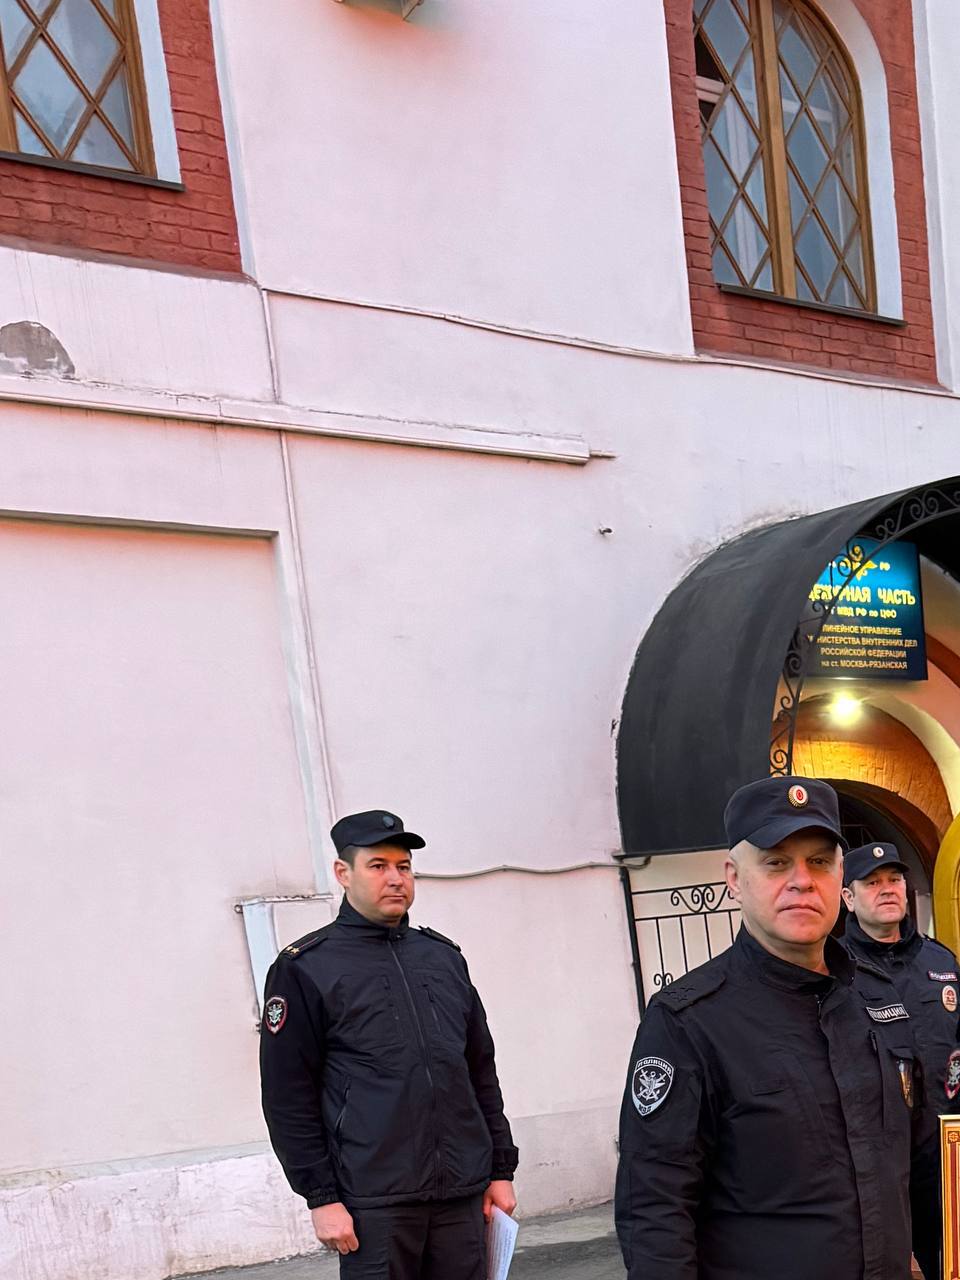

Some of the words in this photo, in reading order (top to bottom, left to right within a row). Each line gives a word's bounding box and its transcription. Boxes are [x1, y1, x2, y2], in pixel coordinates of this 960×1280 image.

[878, 588, 915, 604] ЧАСТЬ
[856, 608, 867, 616] РФ
[880, 609, 896, 618] ЦФО
[822, 624, 860, 634] ЛИНЕЙНОЕ
[860, 626, 902, 635] УПРАВЛЕНИЕ
[861, 638, 903, 647] ВНУТРЕННИХ
[904, 639, 918, 648] ДЕЛ
[820, 647, 866, 657] РОССИЙСКОЙ
[867, 649, 907, 659] ФЕДЕРАЦИИ
[840, 660, 908, 670] МОСКВА-РЯЗАНСКАЯ
